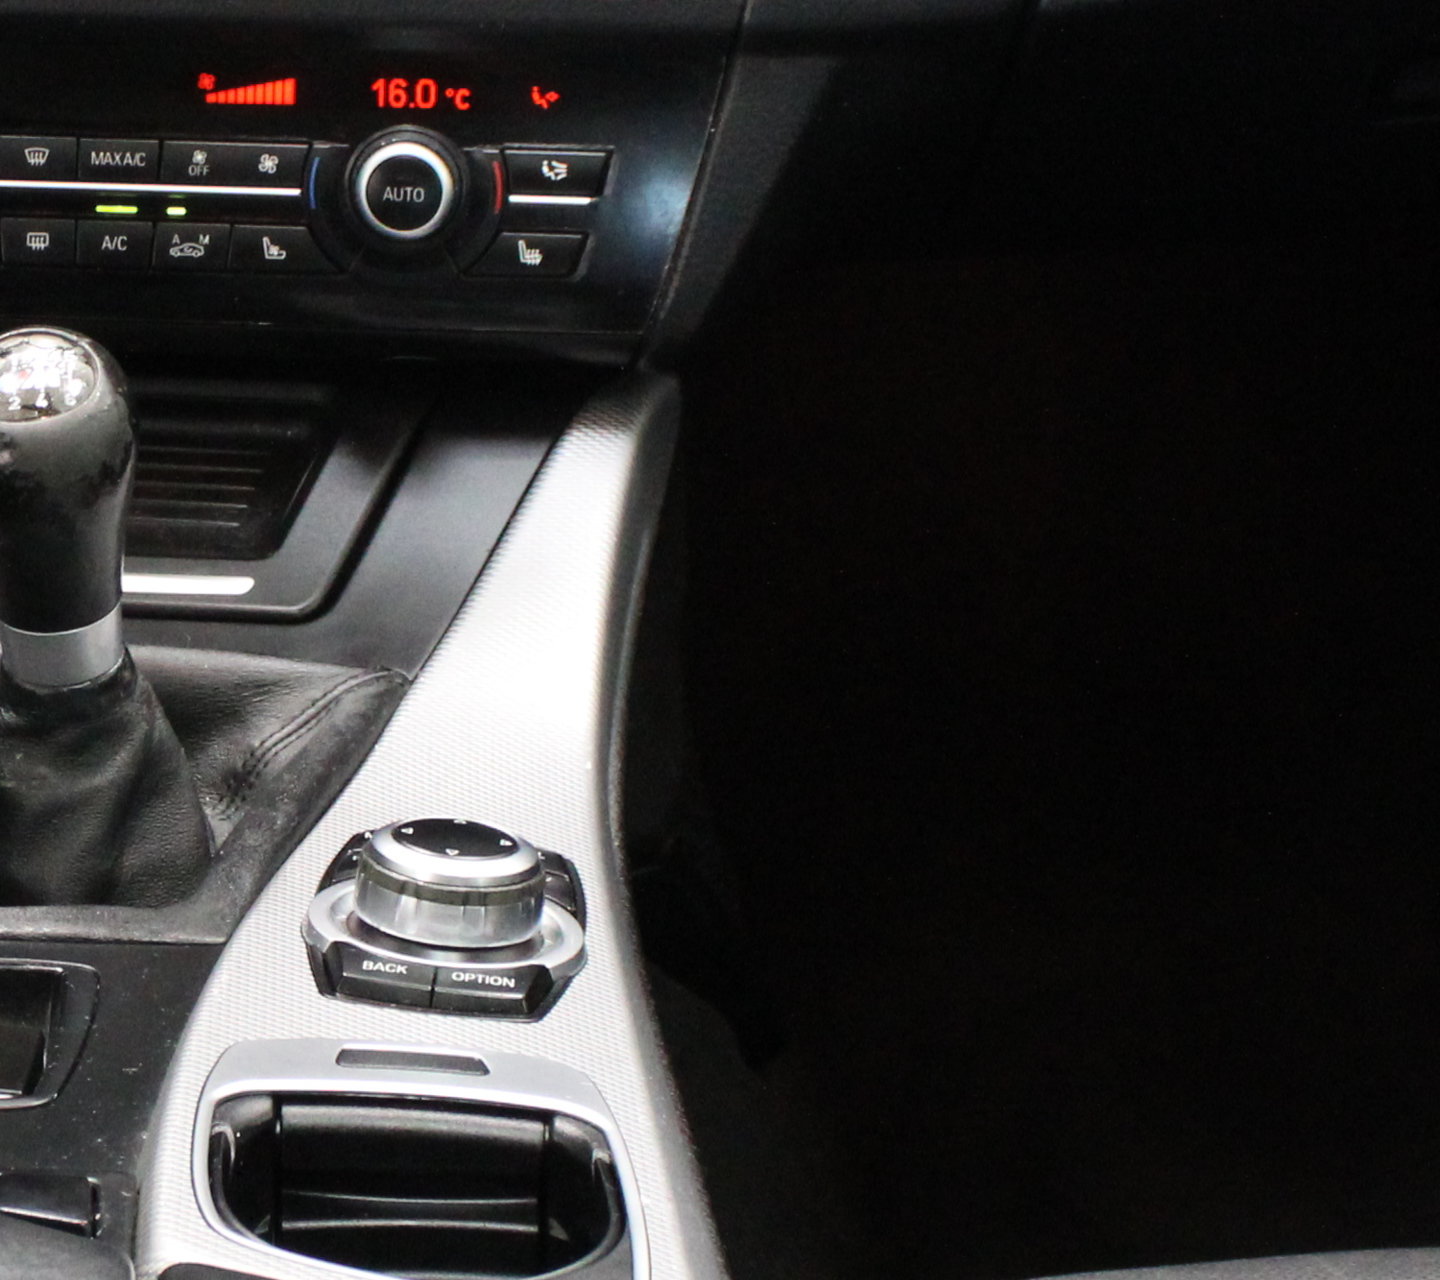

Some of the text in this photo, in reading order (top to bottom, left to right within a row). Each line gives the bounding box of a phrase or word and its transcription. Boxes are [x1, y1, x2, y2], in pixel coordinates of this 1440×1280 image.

[370, 77, 471, 110] 16.0 °C
[91, 151, 146, 167] MAX A/C
[188, 164, 210, 177] OFF
[382, 186, 425, 204] AUTO
[101, 234, 127, 251] A/C
[8, 396, 21, 410] 2
[362, 960, 407, 974] BACK
[452, 971, 516, 988] OPTION
